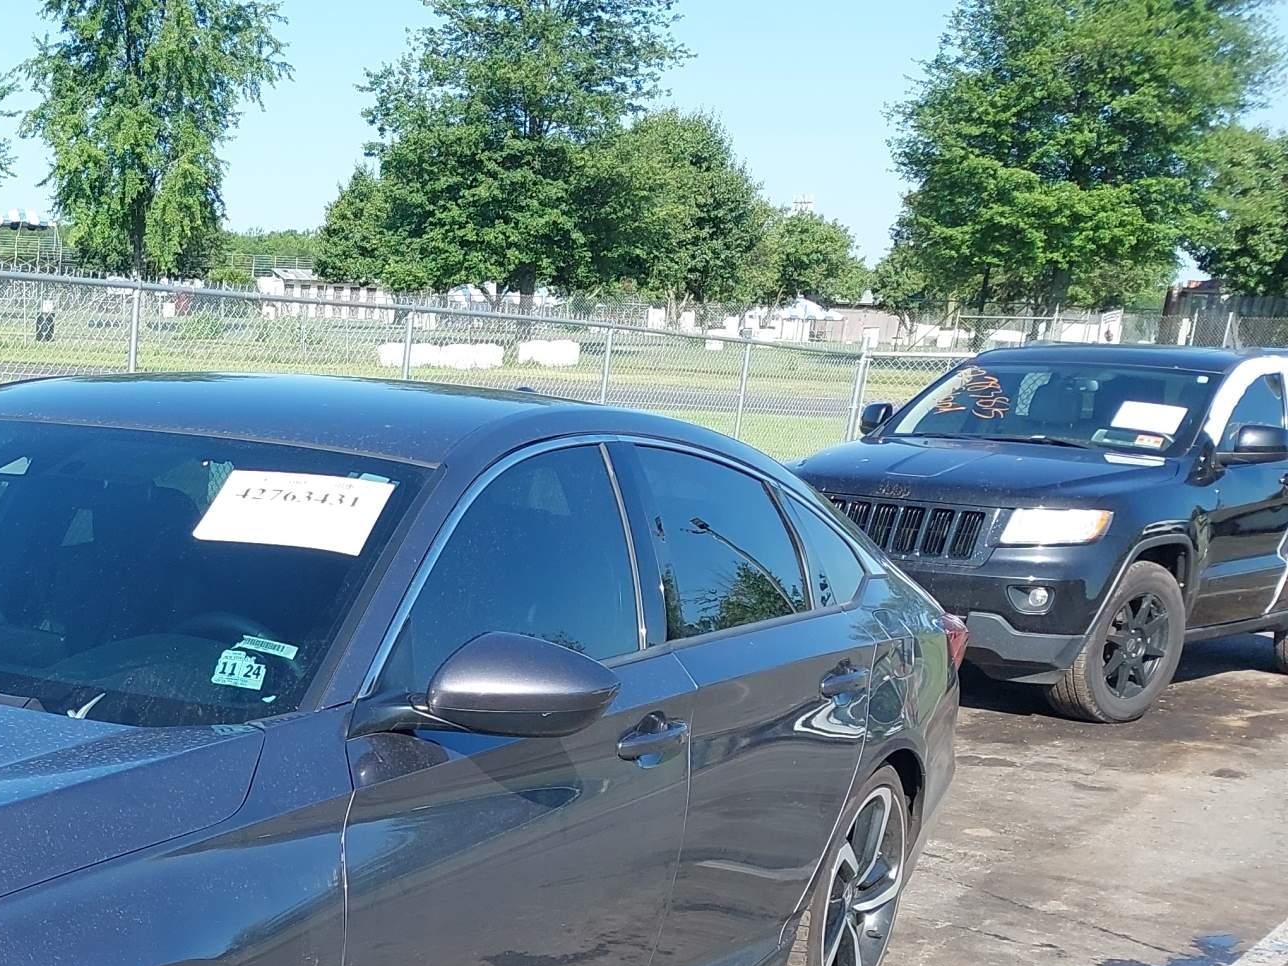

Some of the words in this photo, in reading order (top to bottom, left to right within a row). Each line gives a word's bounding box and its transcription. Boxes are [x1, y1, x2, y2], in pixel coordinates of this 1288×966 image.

[235, 487, 360, 508] 42763431
[218, 660, 237, 676] 11
[242, 663, 262, 679] 24
